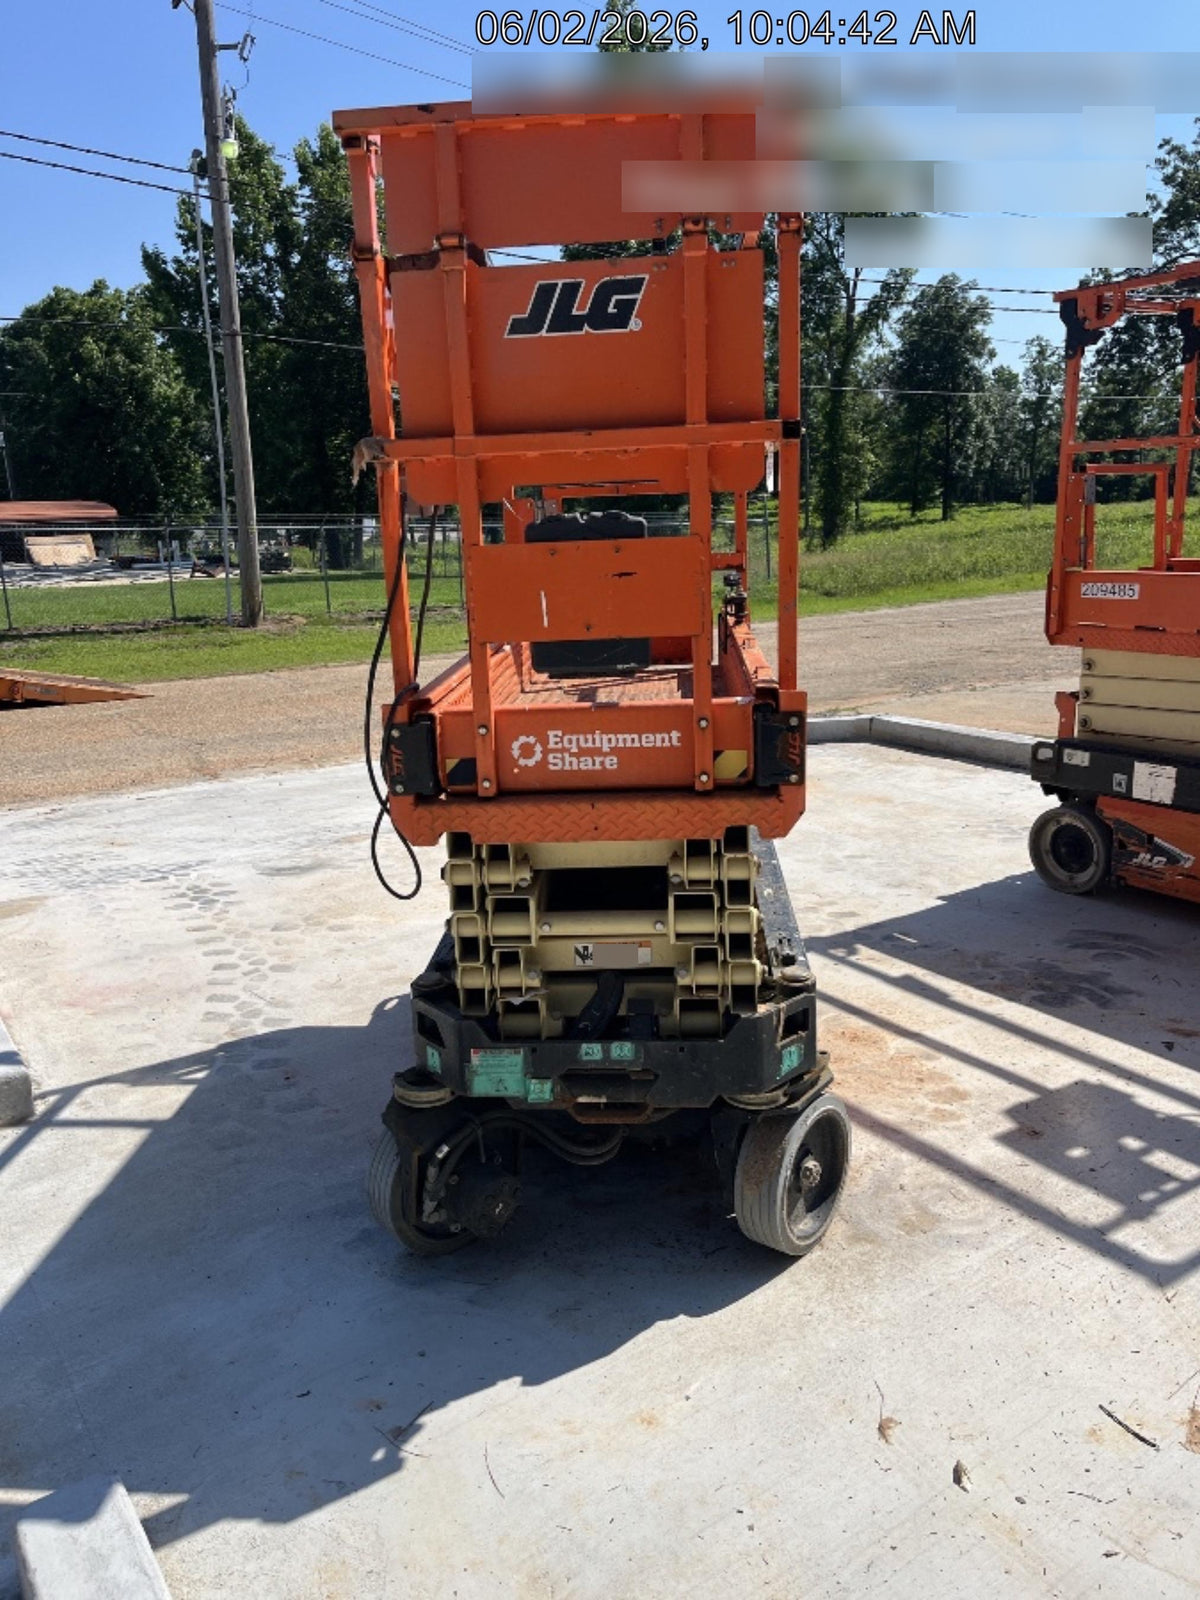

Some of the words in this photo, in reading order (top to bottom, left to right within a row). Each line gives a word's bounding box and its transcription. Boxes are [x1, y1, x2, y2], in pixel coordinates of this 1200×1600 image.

[504, 274, 649, 338] JLG
[1081, 583, 1137, 598] 209485
[547, 730, 682, 752] Equipment
[547, 753, 618, 771] Share
